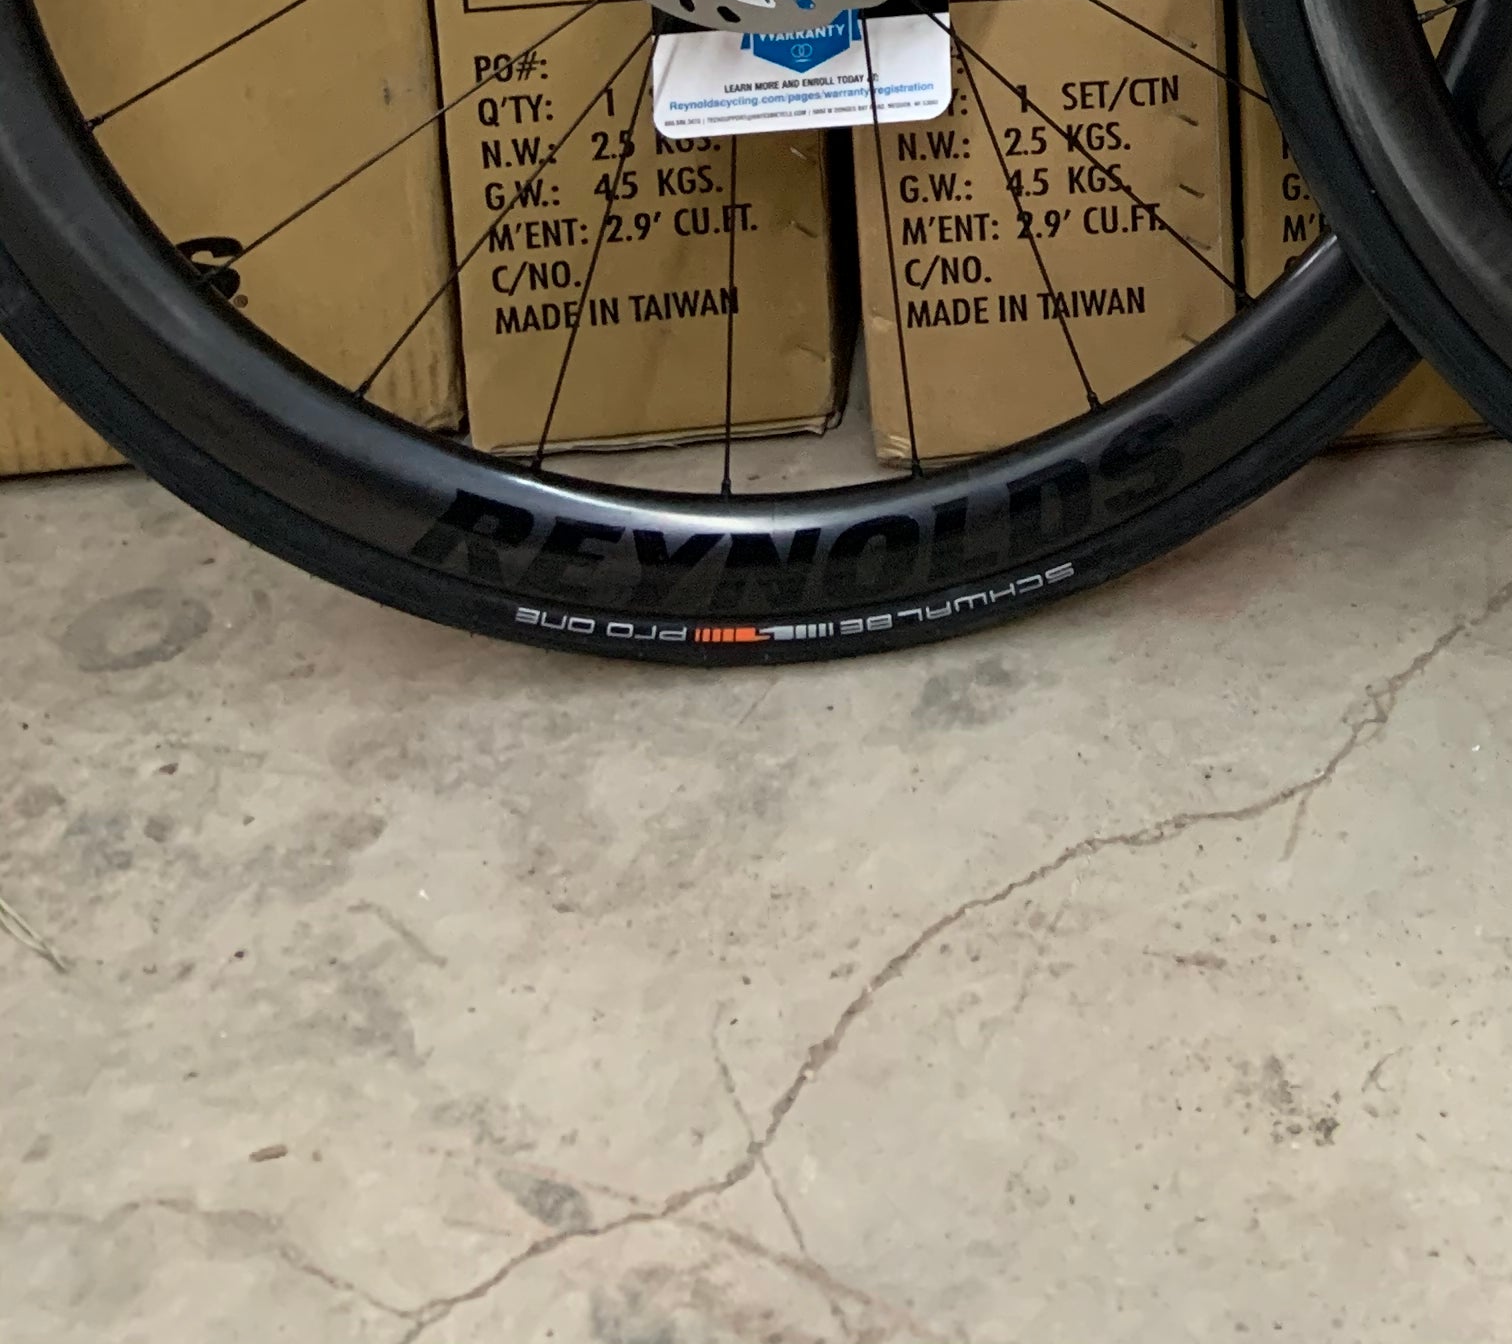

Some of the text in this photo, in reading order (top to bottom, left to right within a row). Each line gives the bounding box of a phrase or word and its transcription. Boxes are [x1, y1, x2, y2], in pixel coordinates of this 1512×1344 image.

[724, 74, 864, 93] LEARN MORE AND ENROLL TODAY
[495, 286, 739, 335] MADE IN TAIWAN
[907, 286, 1146, 329] MADE IN TAIWAN
[410, 412, 1185, 603] REYNOLDS
[840, 560, 1073, 635] SCHWALBE
